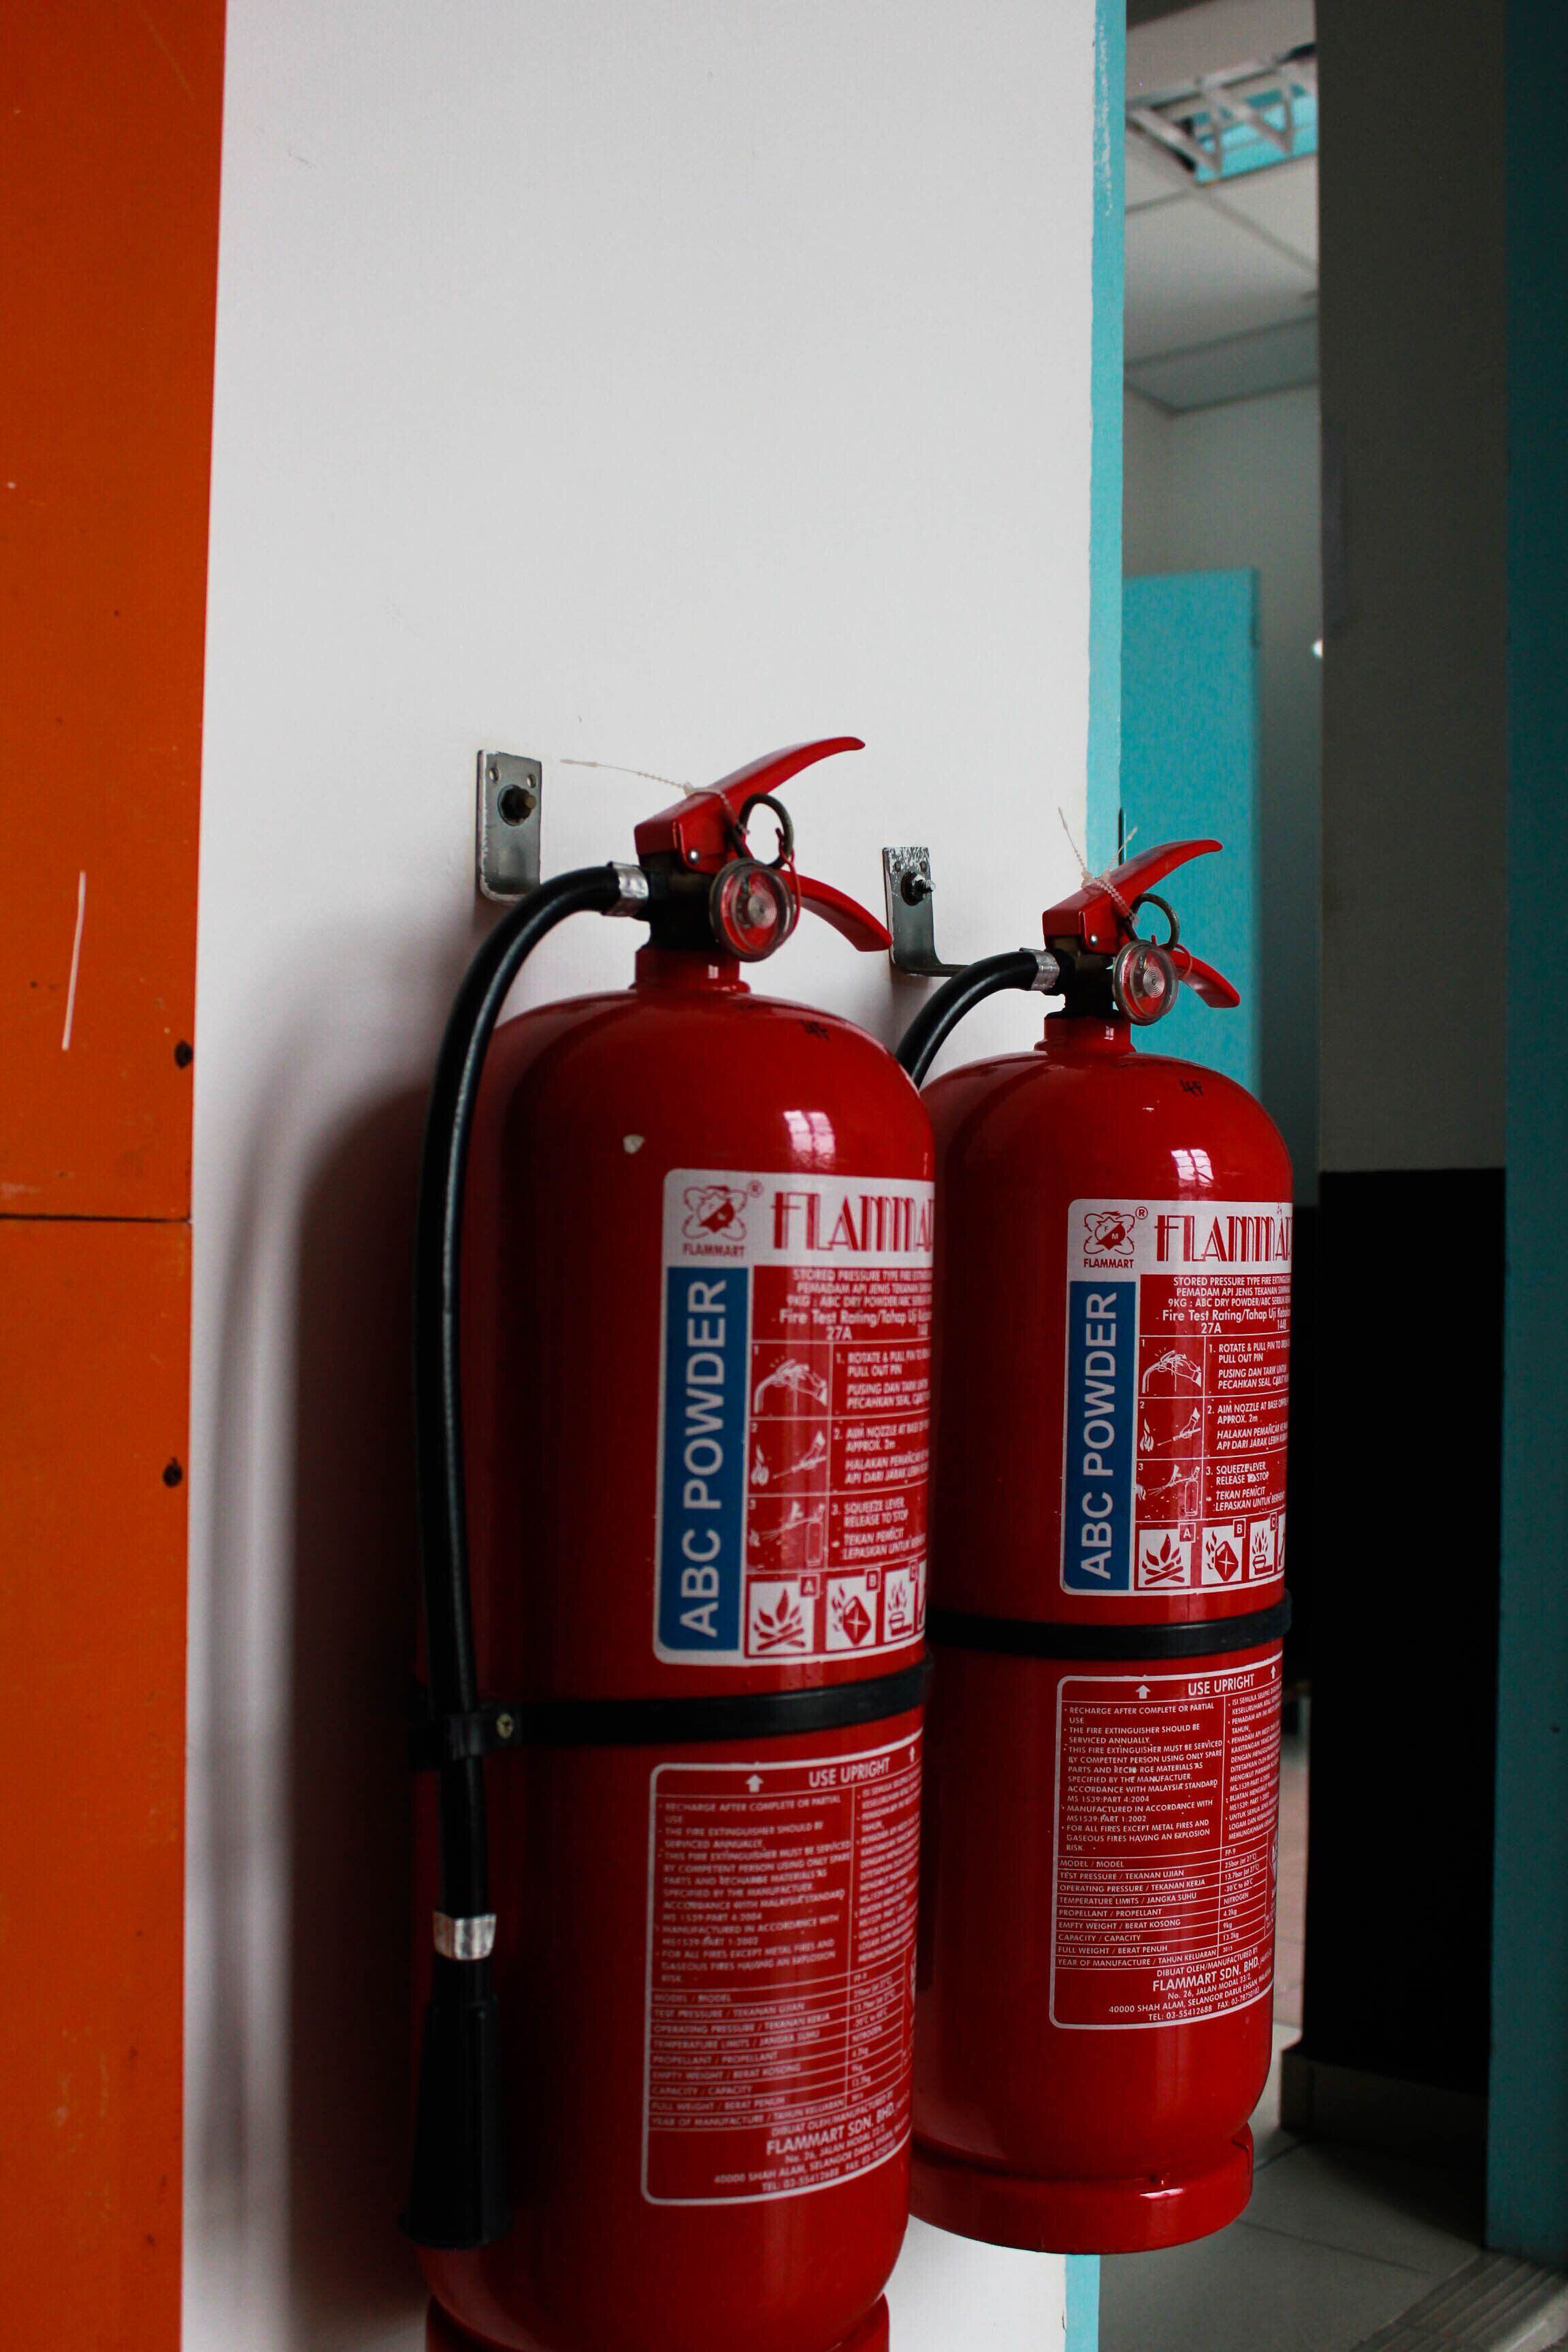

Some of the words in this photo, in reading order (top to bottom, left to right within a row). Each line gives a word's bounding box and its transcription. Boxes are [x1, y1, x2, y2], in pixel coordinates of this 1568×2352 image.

[683, 1243, 745, 1258] FLAMMART
[1083, 1259, 1134, 1268] FLAMMART
[1173, 1277, 1207, 1286] STORED
[1210, 1277, 1244, 1286] PRESSURE
[1247, 1277, 1260, 1285] TYPE
[1261, 1276, 1272, 1285] FIRE
[1177, 1288, 1220, 1296] PEMADAM
[1222, 1288, 1233, 1296] API
[1235, 1287, 1252, 1296] JENIS
[1254, 1287, 1277, 1295] TEKANAN
[1168, 1298, 1187, 1307] 9KG
[1195, 1298, 1212, 1307] ABC
[1215, 1298, 1229, 1307] DRY
[779, 1309, 807, 1324] Fire
[812, 1309, 836, 1324] Test
[1162, 1309, 1185, 1321] Fire
[1189, 1310, 1209, 1321] Test
[1212, 1309, 1267, 1323] Rating/Tahap
[827, 1326, 852, 1340] 27A
[1201, 1323, 1222, 1334] 27A
[1218, 1343, 1245, 1353] ROTATE
[1247, 1343, 1252, 1352] &
[1254, 1342, 1266, 1351] PULL
[1218, 1354, 1236, 1363] PULL
[1238, 1354, 1252, 1362] OUT
[1254, 1352, 1263, 1361] PIN
[1218, 1368, 1246, 1378] PUSING
[1248, 1367, 1262, 1377] DAN
[1083, 1292, 1117, 1476] POWDER
[1218, 1378, 1257, 1390] PECAHKAN
[683, 1281, 726, 1509] POWDER
[1218, 1405, 1232, 1414] AIM
[1235, 1402, 1259, 1413] NOZZLE
[1260, 1402, 1267, 1411] AT
[1218, 1415, 1247, 1424] APPROX.
[1249, 1414, 1258, 1422] 2m
[1217, 1427, 1252, 1439] HALAKAN
[1216, 1441, 1229, 1451] API
[1232, 1440, 1248, 1450] DARI
[1250, 1438, 1267, 1448] JARAK
[1216, 1474, 1245, 1486] RELEASE
[1216, 1490, 1240, 1501] TEKAN
[1215, 1499, 1252, 1512] LEPASKAN
[1183, 1529, 1191, 1539] A
[1237, 1524, 1243, 1534] B
[1081, 1492, 1113, 1580] ABC
[680, 1529, 721, 1637] ABC
[1188, 1682, 1210, 1696] USE
[1214, 1673, 1255, 1693] UPRIGHT
[1139, 1705, 1176, 1714] COMPLETE
[1190, 1703, 1214, 1711] PARTIAL
[1162, 1725, 1190, 1733] SHOULD
[1107, 1746, 1161, 1754] EXTINGUISHER
[1194, 1740, 1222, 1750] SERVICED
[1130, 1756, 1159, 1764] PERSON
[1162, 1754, 1184, 1763] USING
[1186, 1752, 1204, 1761] ONLY
[1205, 1750, 1222, 1758] SPARE
[809, 1769, 836, 1788] USE
[840, 1757, 891, 1783] UPRIGHT
[1157, 1763, 1193, 1772] MATERIALS
[1068, 1785, 1124, 1793] ACCORDANCE
[1148, 1783, 1183, 1792] MALAYSIA
[1185, 1779, 1218, 1789] STANDARD
[1067, 1805, 1132, 1813] MANUFACTURED
[1145, 1803, 1195, 1812] ACCORDANCE
[1196, 1799, 1213, 1808] WITH
[1152, 1823, 1174, 1831] METAL
[1176, 1821, 1193, 1829] FIRES
[1066, 1834, 1105, 1842] GASEOUS
[1129, 1833, 1159, 1842] HAVING
[1125, 1872, 1160, 1880] TEKANAN
[1163, 1869, 1184, 1878] UJIAN
[1060, 1884, 1104, 1893] OPERATING
[1107, 1884, 1143, 1893] PRESSURE
[1152, 1882, 1185, 1891] TEKANAN
[1187, 1878, 1205, 1886] KERJA
[1060, 1897, 1113, 1905] TEMPERATURE
[1147, 1895, 1176, 1904] JANGKA
[1178, 1893, 1197, 1901] SUHU
[1059, 1909, 1107, 1917] PROPELLANT
[1116, 1908, 1162, 1917] PROPELLANT
[1125, 1921, 1147, 1929] BERAT
[1149, 1918, 1181, 1928] KOSONG
[1058, 1933, 1096, 1942] CAPACITY
[1105, 1934, 1141, 1942] CAPACITY
[1143, 1945, 1168, 1953] PENUH
[1092, 1958, 1151, 1967] MANUFACTURE
[1158, 1955, 1182, 1965] TAHUN
[1184, 1948, 1216, 1961] KELUARAN
[1157, 1967, 1185, 1977] DIBUAT
[1187, 1950, 1252, 1974] OLEH/MANUFACTURED
[1153, 1971, 1216, 1991] FLAMMART
[1220, 1965, 1241, 1980] SDN.
[1244, 1957, 1259, 1972] BHD.
[1168, 1991, 1181, 1999] No.
[1196, 1984, 1216, 1995] JALAN
[1219, 1979, 1239, 1991] MODAL
[1137, 2004, 1160, 2012] SHAH
[1188, 1993, 1223, 2006] SELANGOR
[1225, 1987, 1242, 1999] DARUL
[1149, 2013, 1163, 2021] TEL:
[1166, 2005, 1212, 2019] 03-55412688
[766, 2127, 845, 2155] FLAMMART
